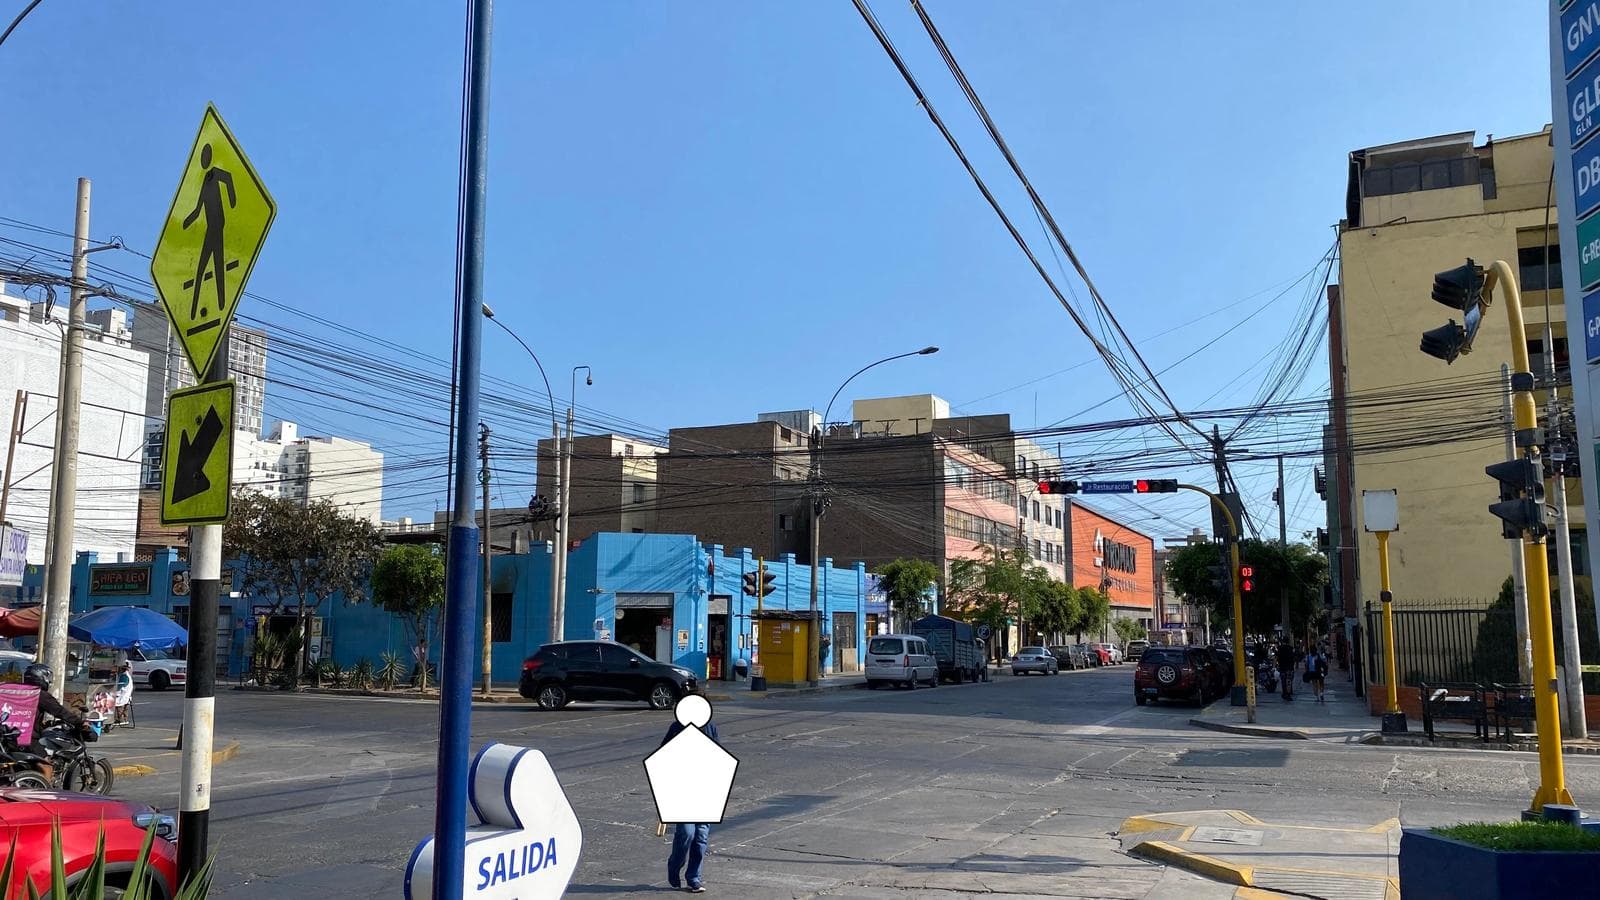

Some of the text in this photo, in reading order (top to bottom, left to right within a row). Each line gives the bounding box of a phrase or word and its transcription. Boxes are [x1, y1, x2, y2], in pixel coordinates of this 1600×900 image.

[1575, 115, 1592, 136] GLN
[1242, 567, 1252, 577] 03
[477, 837, 557, 891] SALIDA
